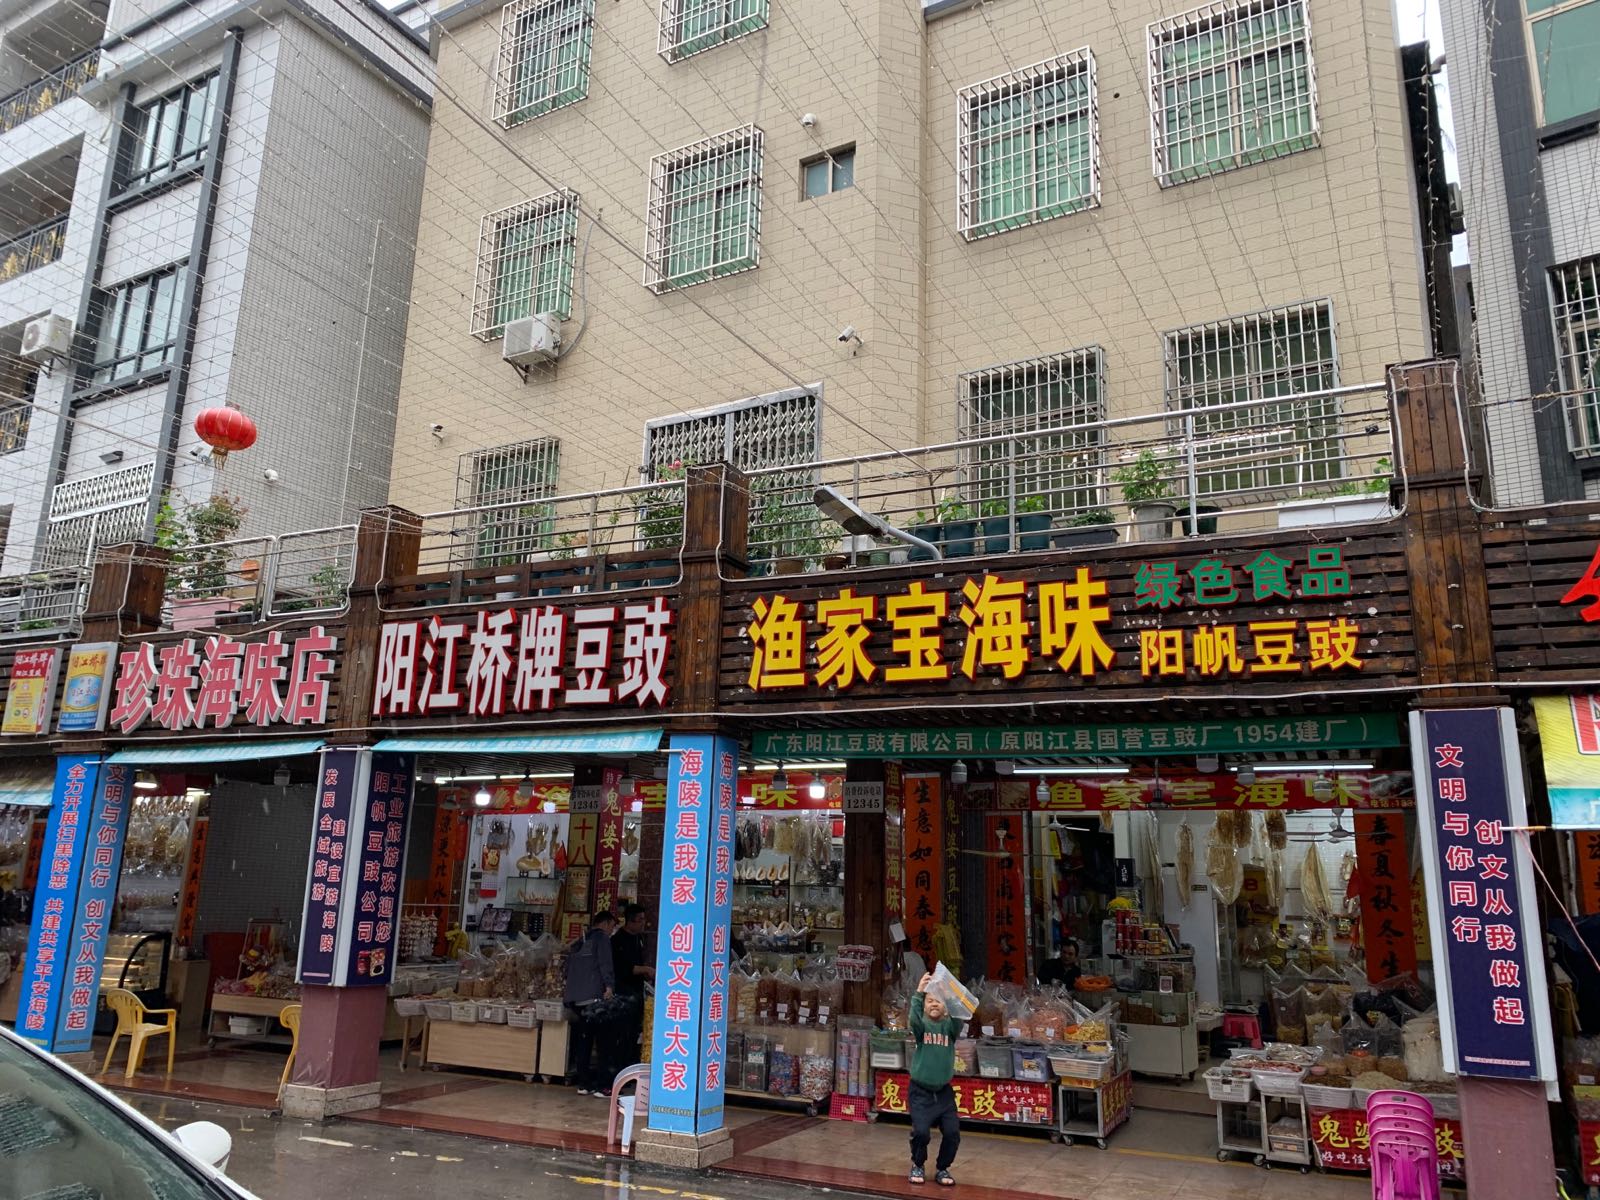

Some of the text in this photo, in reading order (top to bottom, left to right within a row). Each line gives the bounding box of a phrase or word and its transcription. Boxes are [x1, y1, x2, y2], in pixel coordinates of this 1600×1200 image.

[748, 568, 1115, 691] 渔家宝海味
[1135, 545, 1351, 609] 绿色食品
[111, 626, 337, 734] 珍珠海味店
[373, 597, 675, 716] 阳江桥牌豆豉
[1141, 617, 1363, 676] 阳帆豆豉
[48, 763, 86, 890] 全力开展扫黑除恶
[90, 764, 127, 889] 文明与你同行
[312, 768, 338, 901] 发展全域旅游
[358, 771, 391, 942] 阳帆豆豉公司
[376, 773, 407, 943] 工业旅游欢迎您
[572, 800, 599, 810] 12345
[672, 749, 703, 904] 海陵是我家
[714, 752, 734, 907] 海陵是我家
[847, 798, 880, 809] 12345
[1435, 743, 1481, 943] 文明与你同行
[320, 819, 346, 952] 建设宜游海陵
[1474, 819, 1525, 1025] 创文从我做起
[25, 897, 64, 1031] 共建共享平安海陵
[65, 898, 105, 1032] 创文从我做起
[663, 923, 693, 1092] 创文靠大家
[705, 924, 726, 1091] 创文靠大家
